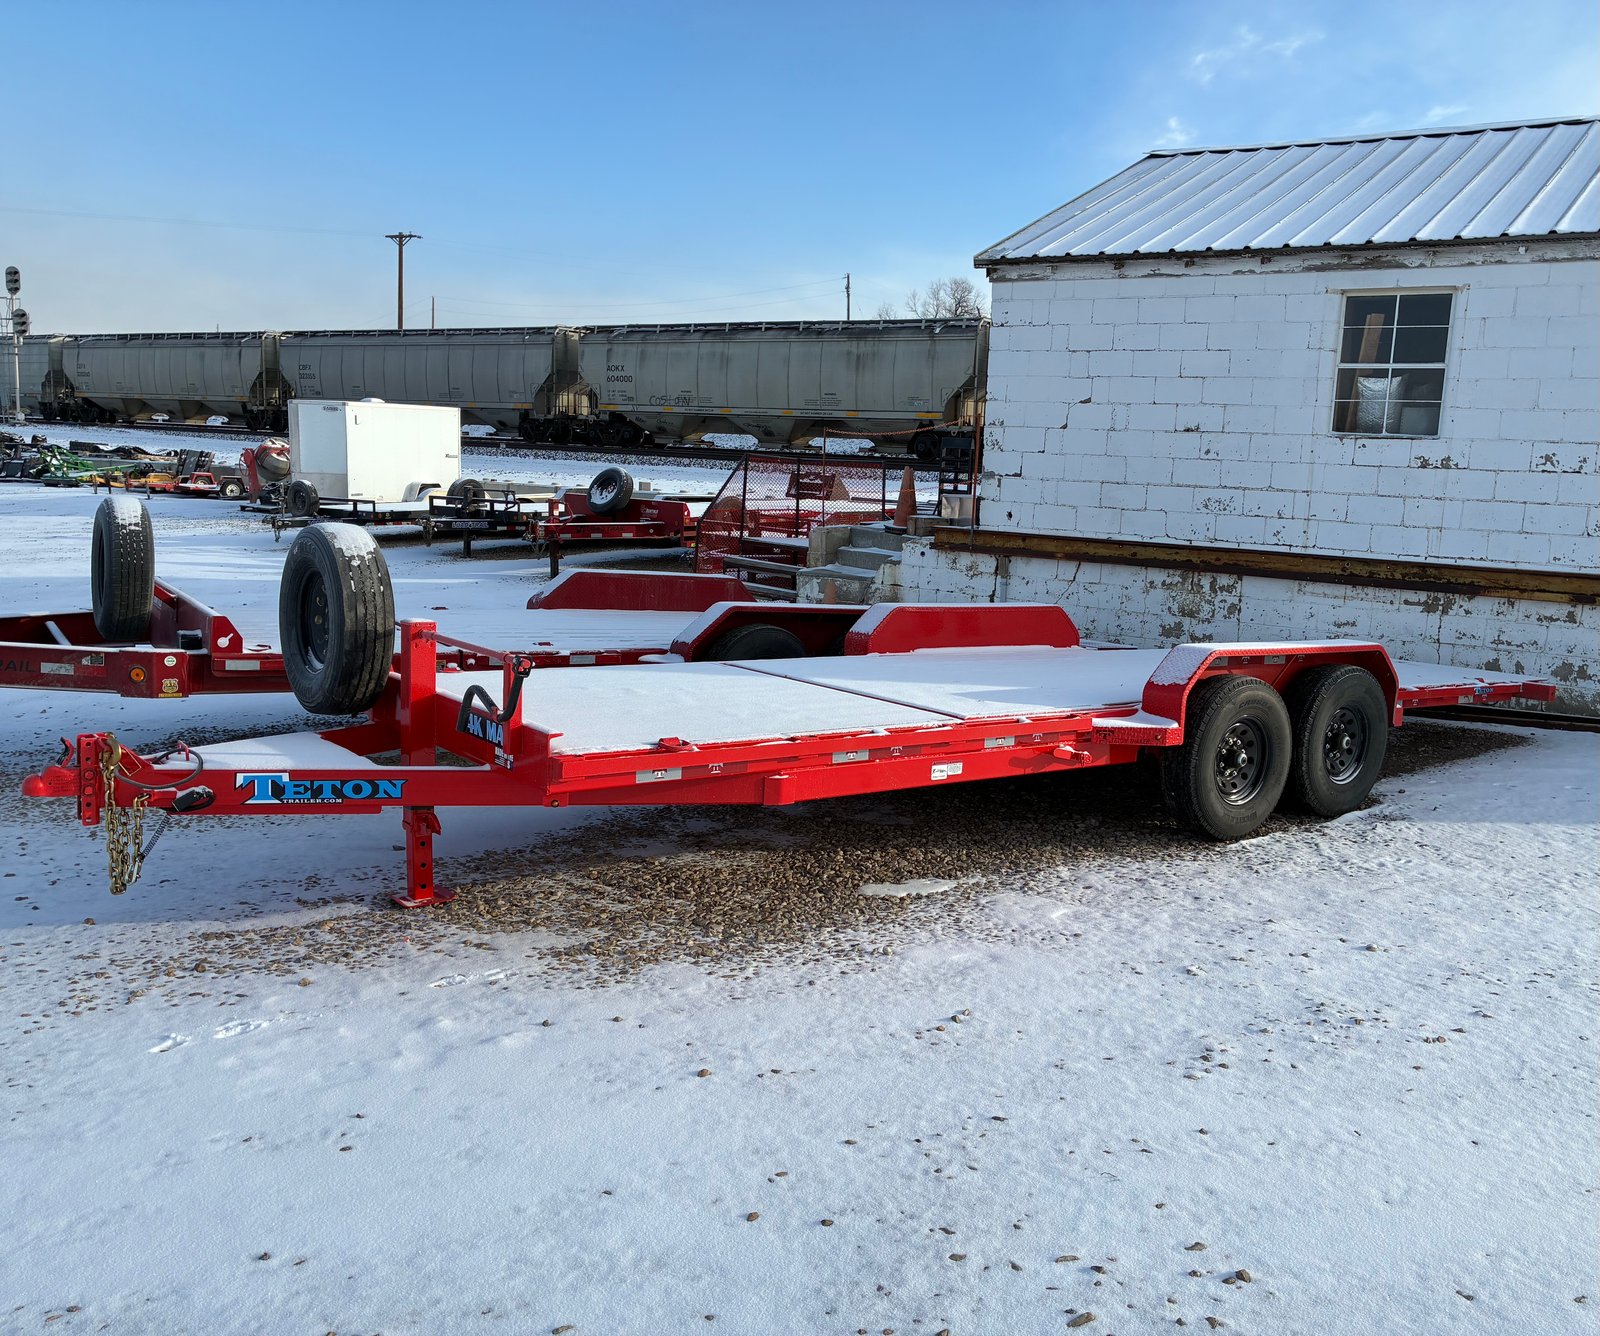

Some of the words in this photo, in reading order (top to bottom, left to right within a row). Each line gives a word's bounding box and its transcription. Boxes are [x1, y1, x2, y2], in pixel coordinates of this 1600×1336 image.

[606, 364, 625, 373] AOKX
[606, 375, 633, 383] 604000
[0, 658, 36, 673] AIL
[235, 772, 407, 804] TETON
